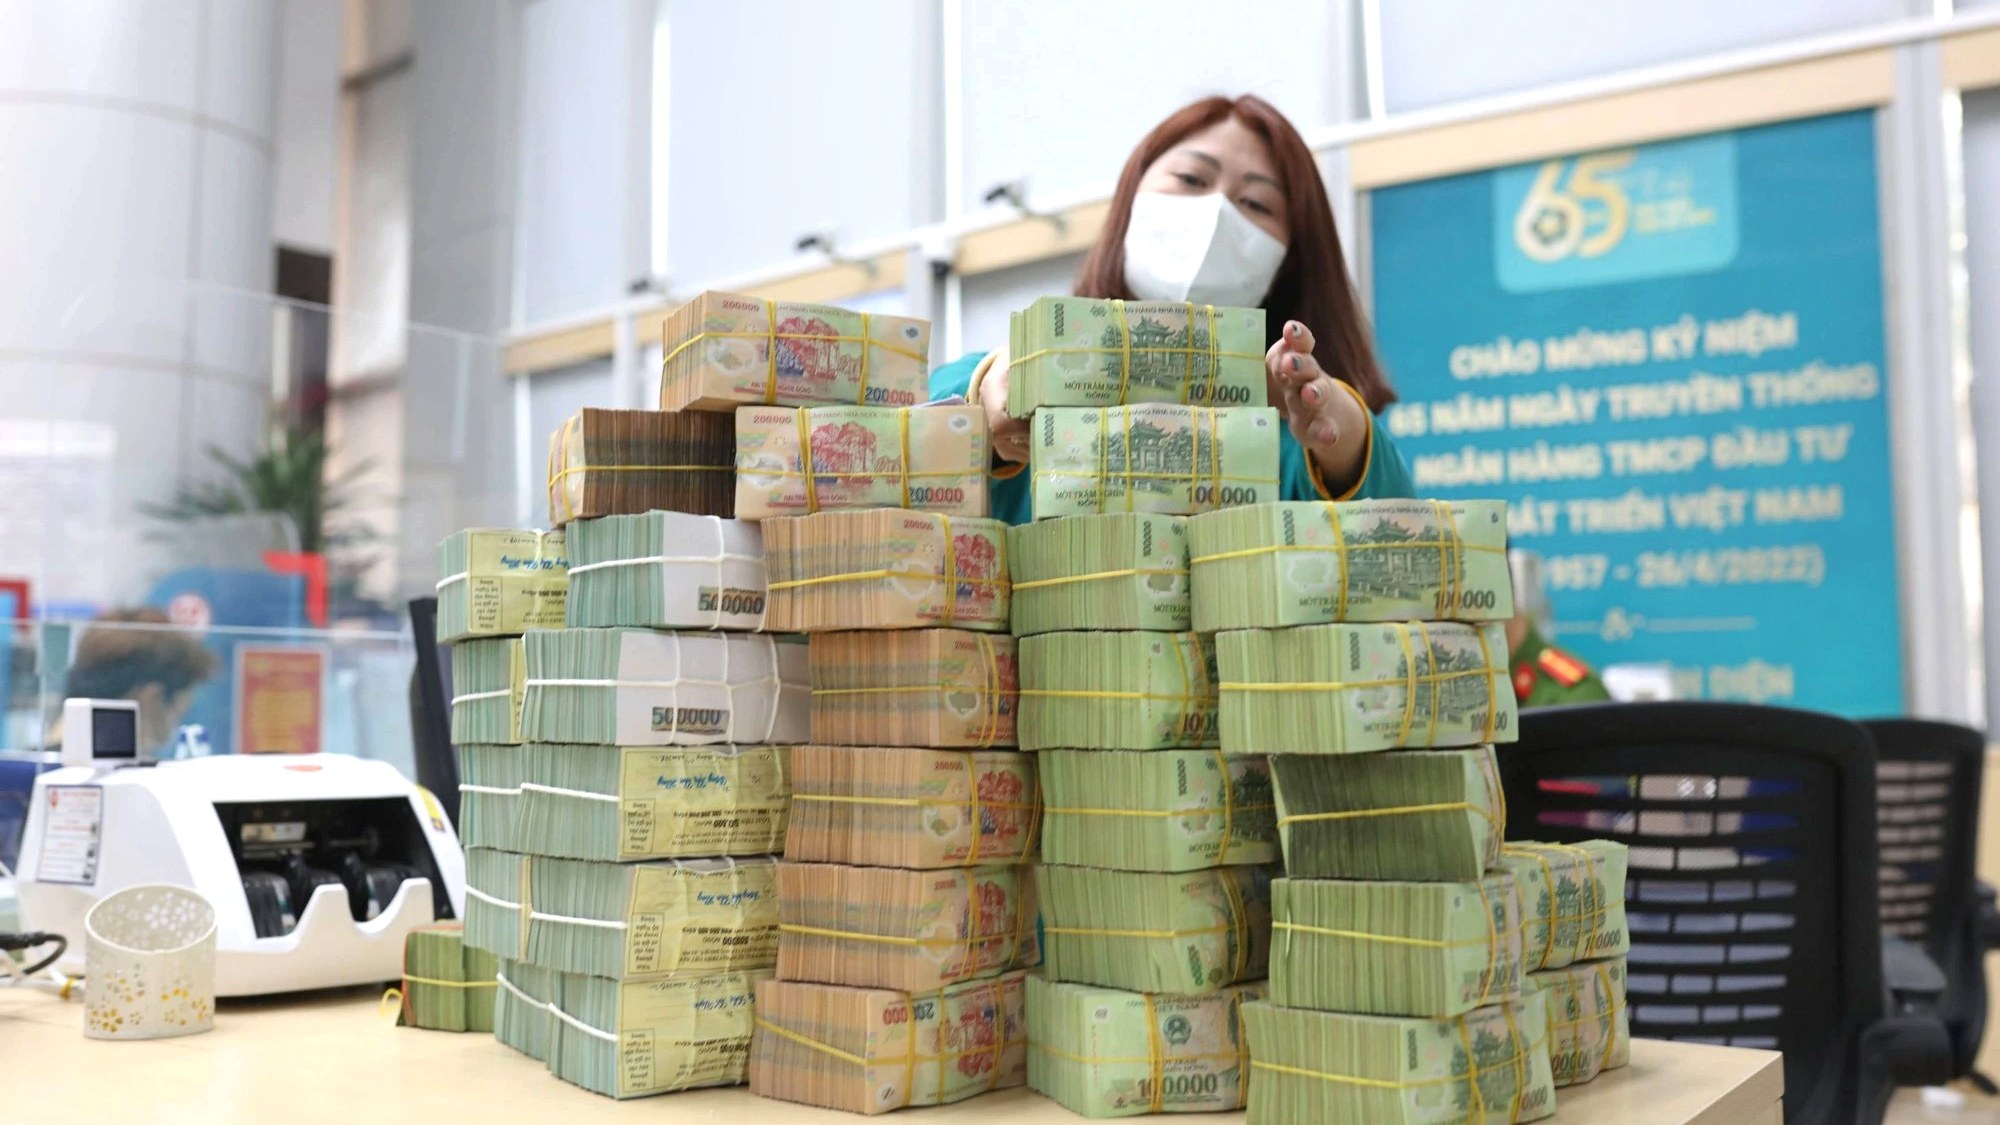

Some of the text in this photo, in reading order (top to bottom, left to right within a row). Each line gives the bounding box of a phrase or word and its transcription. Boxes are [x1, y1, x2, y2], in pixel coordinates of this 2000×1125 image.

[1515, 151, 1636, 264] 65
[1450, 337, 1540, 379] CHÀO
[1544, 327, 1647, 370] MỪNG
[1704, 310, 1798, 357] NIỆM
[865, 387, 915, 405] 200000
[1388, 359, 1878, 437] 65 NĂM NGÀY TRUYỀN THỐNG
[1413, 444, 1503, 487] NGÂN
[1508, 440, 1602, 482] HÀNG
[1605, 435, 1706, 475] TMCP
[1711, 424, 1788, 469] ĐẦU
[1566, 487, 1664, 534] TRIỂN
[1669, 484, 1748, 532] VIỆT
[1753, 485, 1844, 523] NAM
